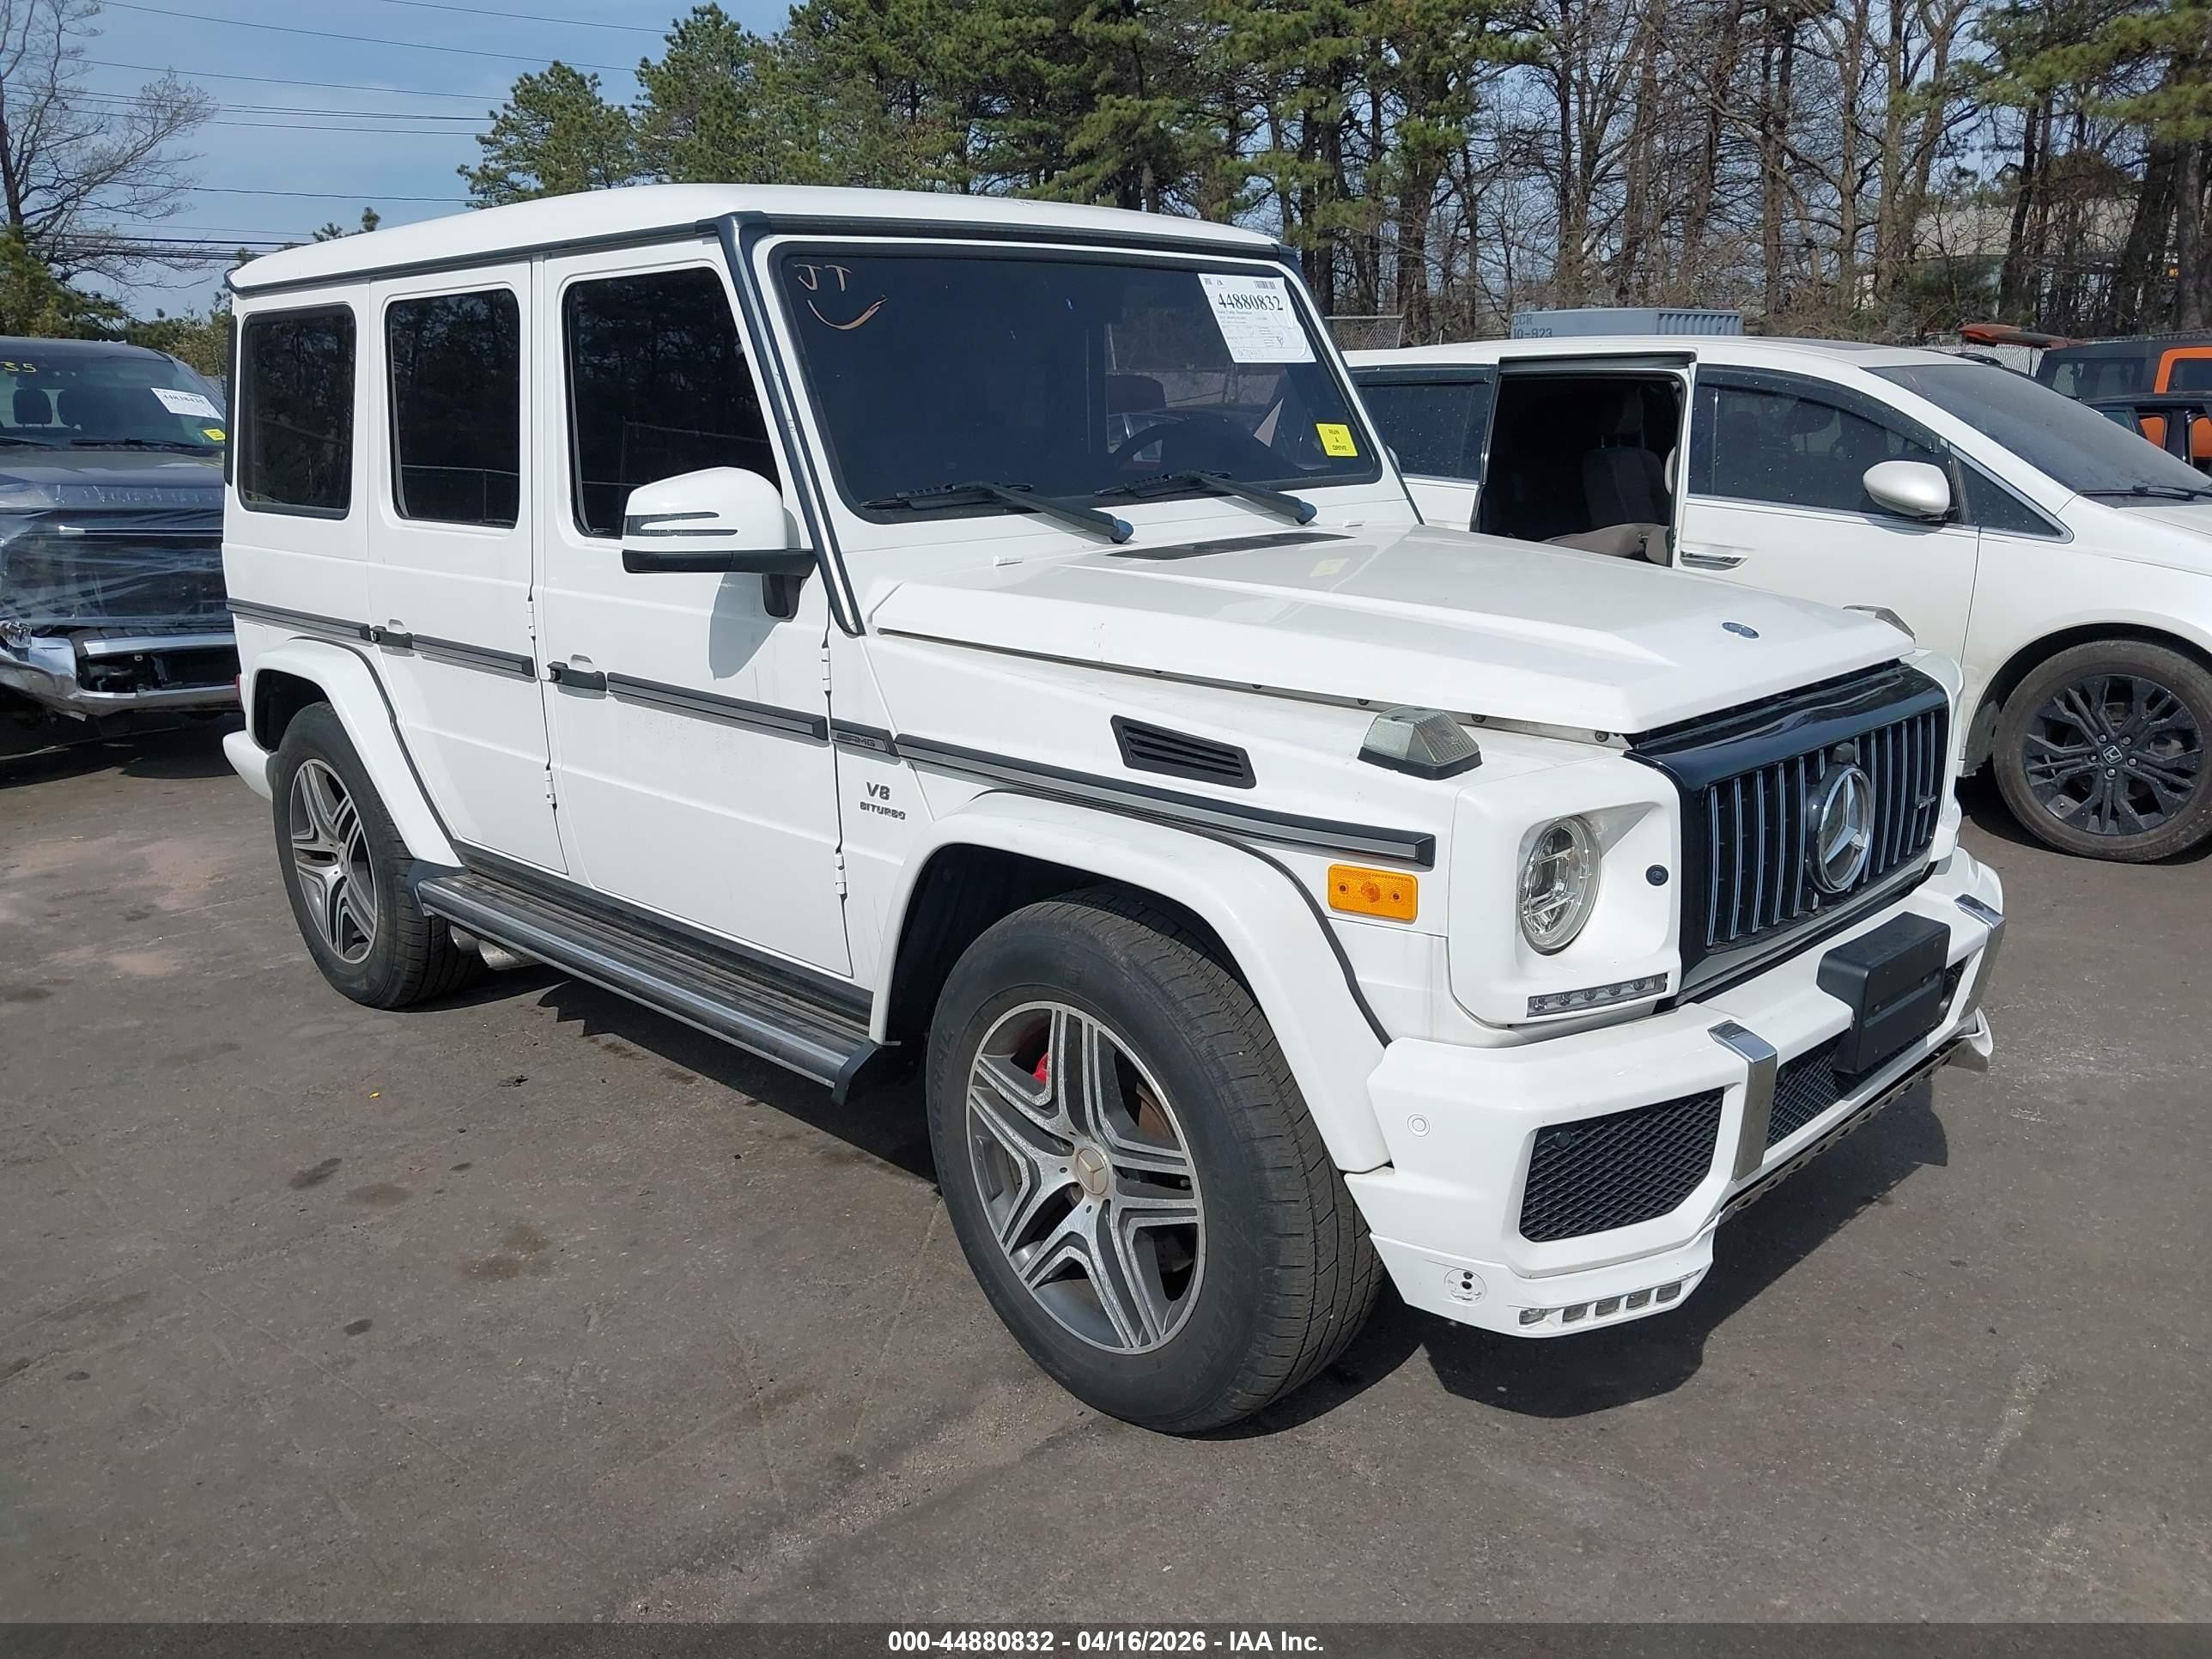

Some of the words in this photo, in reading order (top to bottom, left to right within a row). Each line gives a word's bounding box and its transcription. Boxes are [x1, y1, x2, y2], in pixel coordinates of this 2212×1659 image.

[1218, 293, 1284, 311] 44880832
[1512, 314, 1533, 325] CCR
[847, 735, 876, 747] AMG
[866, 781, 890, 800] V8
[860, 801, 907, 821] BITURBO
